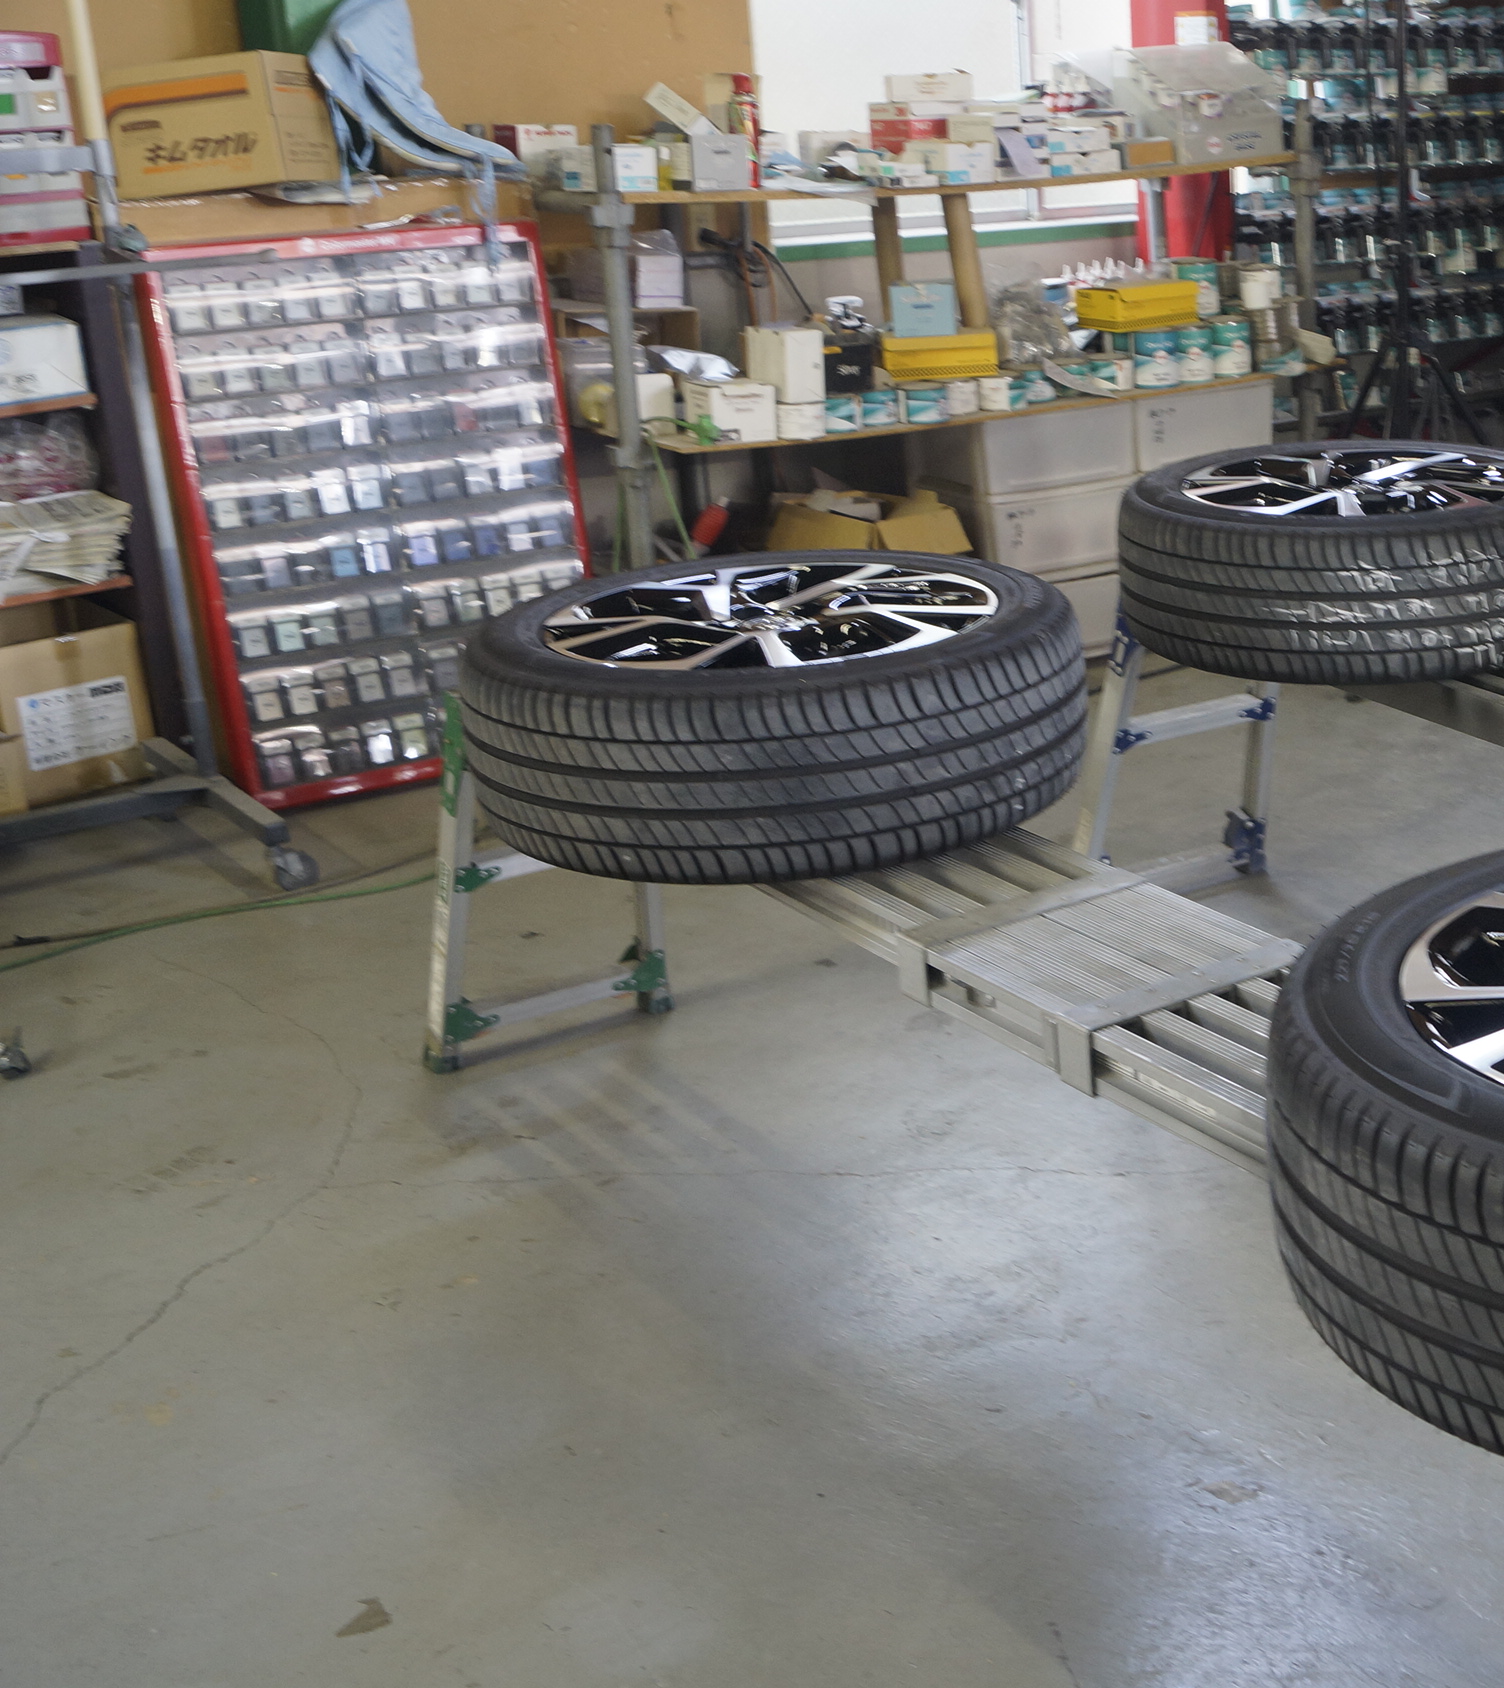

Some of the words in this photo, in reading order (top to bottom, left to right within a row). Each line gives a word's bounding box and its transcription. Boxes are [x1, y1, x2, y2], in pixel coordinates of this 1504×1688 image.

[145, 131, 258, 165] キムタオル
